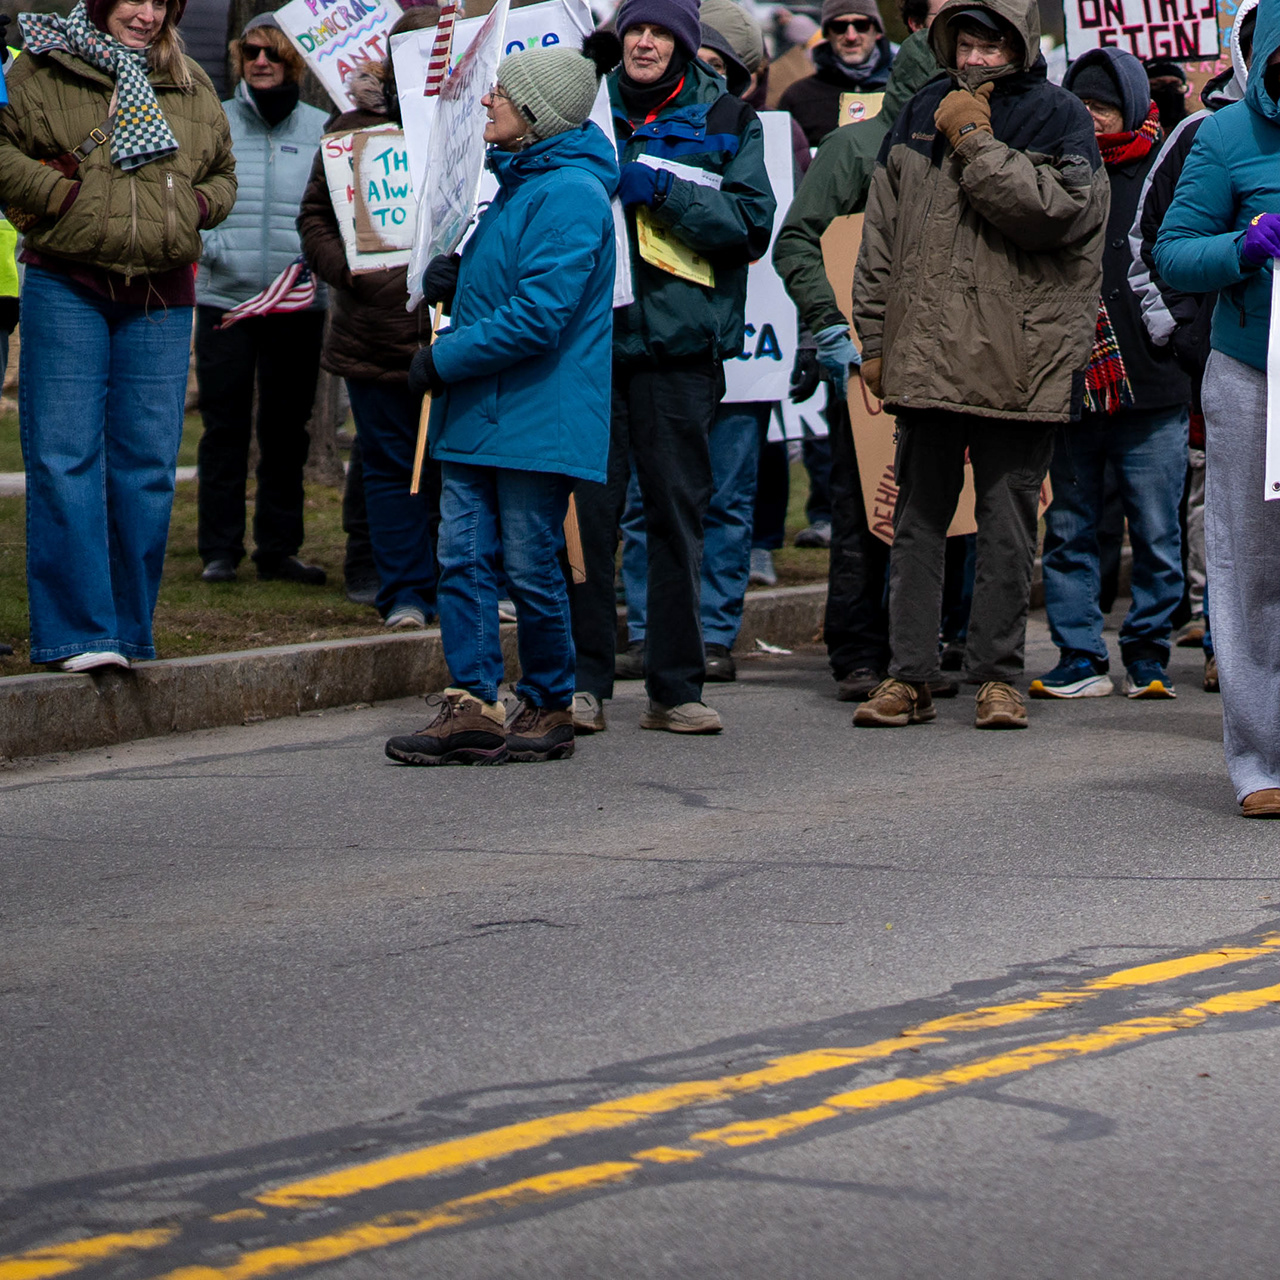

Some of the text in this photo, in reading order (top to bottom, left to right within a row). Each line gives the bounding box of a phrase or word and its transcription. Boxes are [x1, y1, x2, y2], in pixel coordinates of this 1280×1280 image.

[337, 30, 389, 83] ANT
[1098, 21, 1201, 61] SIGN
[372, 207, 407, 227] TO
